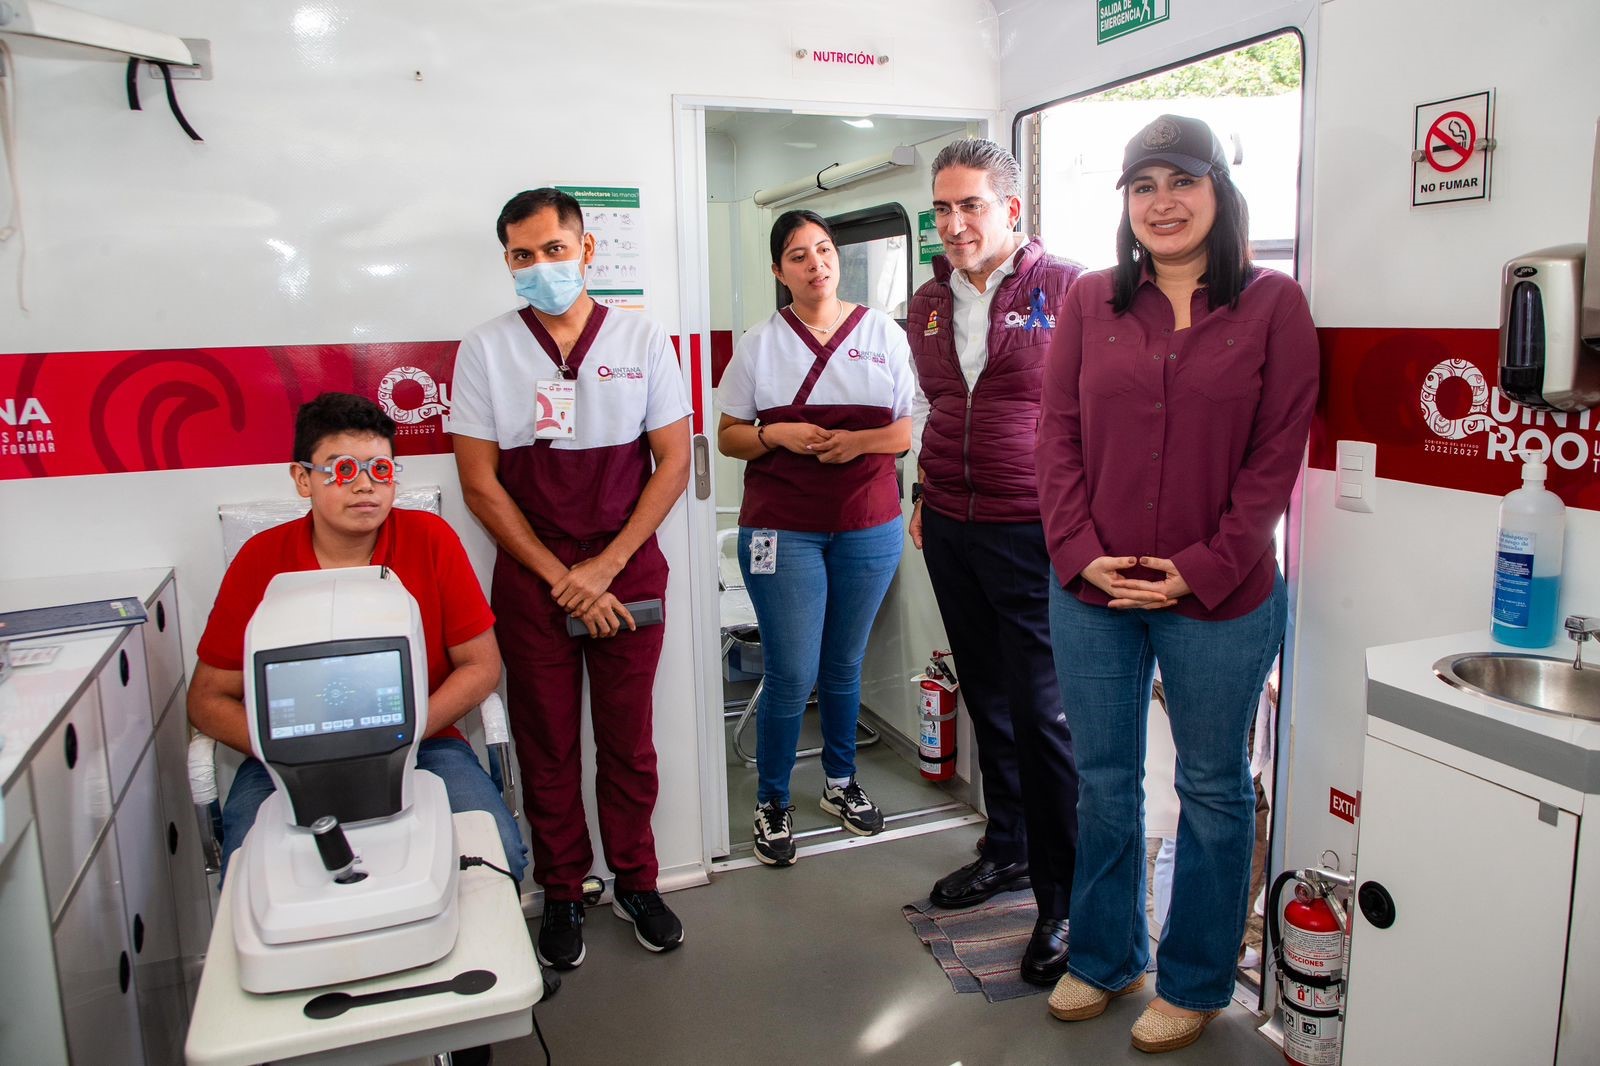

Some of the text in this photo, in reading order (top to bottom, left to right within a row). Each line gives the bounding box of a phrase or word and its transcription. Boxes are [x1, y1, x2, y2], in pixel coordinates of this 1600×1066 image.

[1100, 0, 1132, 19] SALIDA DE
[1100, 6, 1141, 33] EMERGENCIA
[813, 51, 875, 65] NUTRICIÓN
[1420, 177, 1478, 193] NO FUMAR
[16, 430, 54, 442] PARA
[1487, 425, 1589, 470] ROO
[1333, 795, 1356, 818] EXTI
